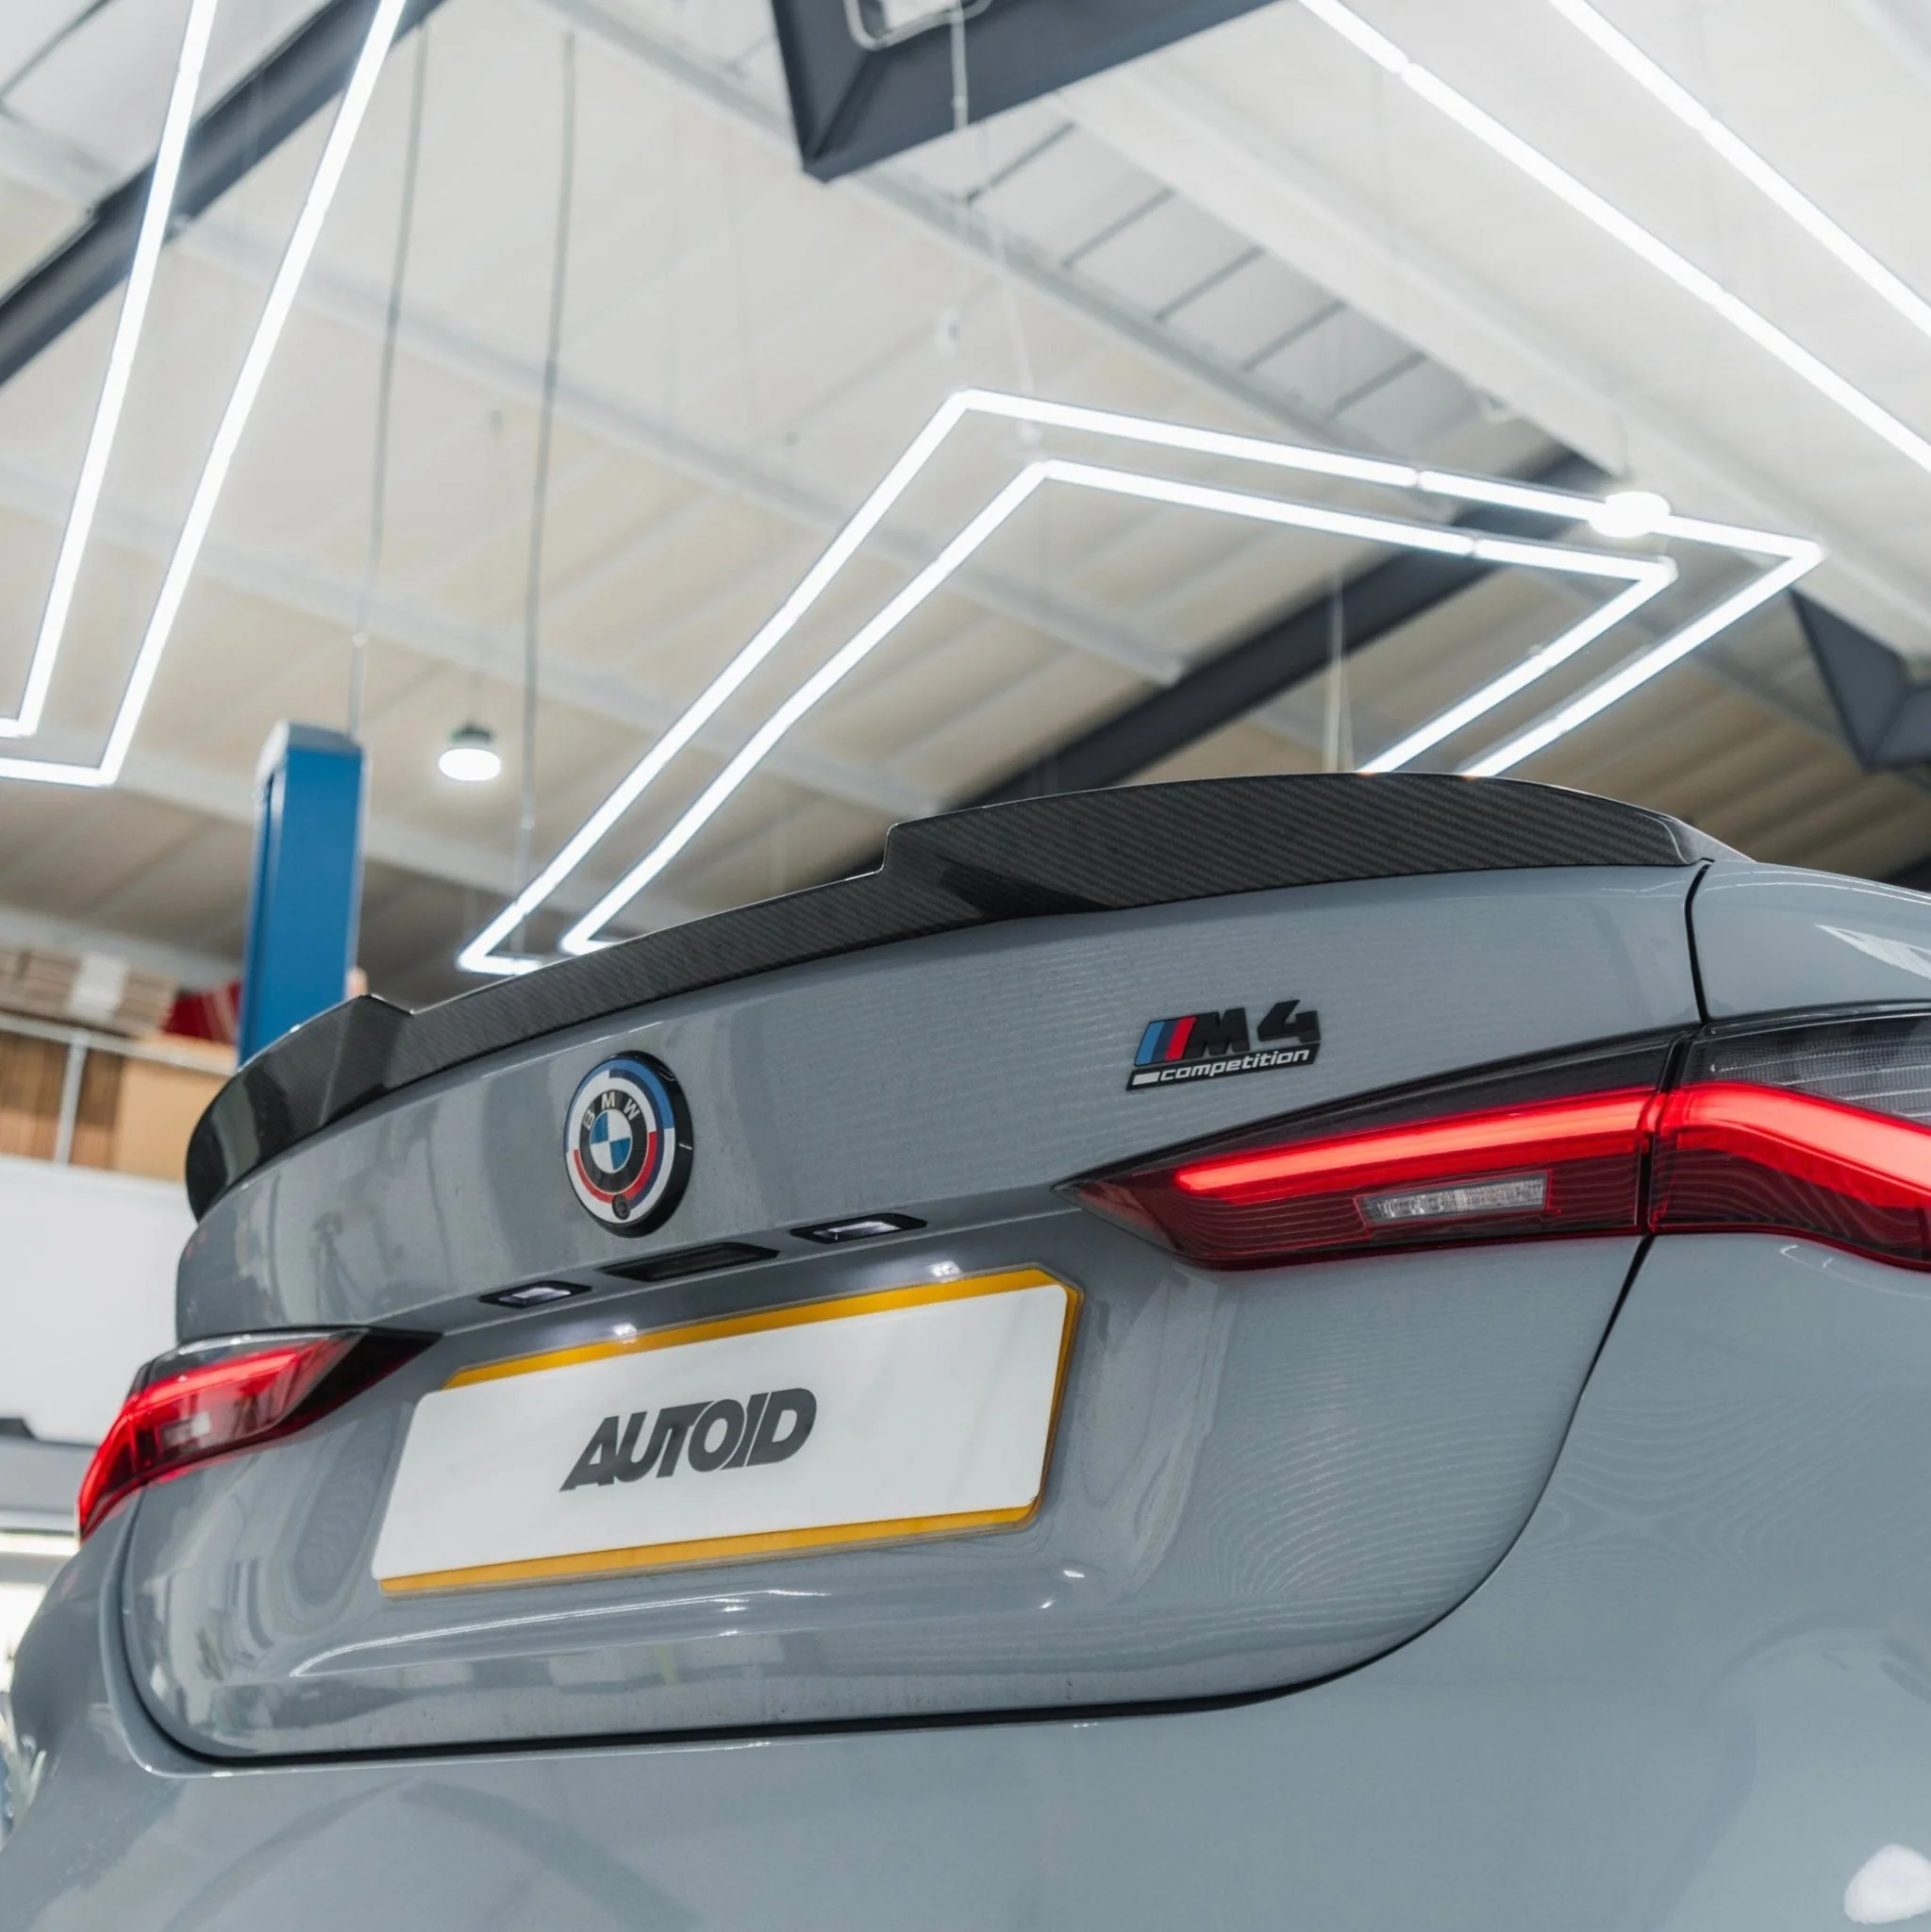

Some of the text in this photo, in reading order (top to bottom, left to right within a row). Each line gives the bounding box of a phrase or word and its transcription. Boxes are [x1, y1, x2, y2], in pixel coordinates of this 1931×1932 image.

[1160, 1049, 1310, 1082] competition
[582, 1091, 641, 1131] BMW
[558, 1388, 818, 1492] AUTOID
